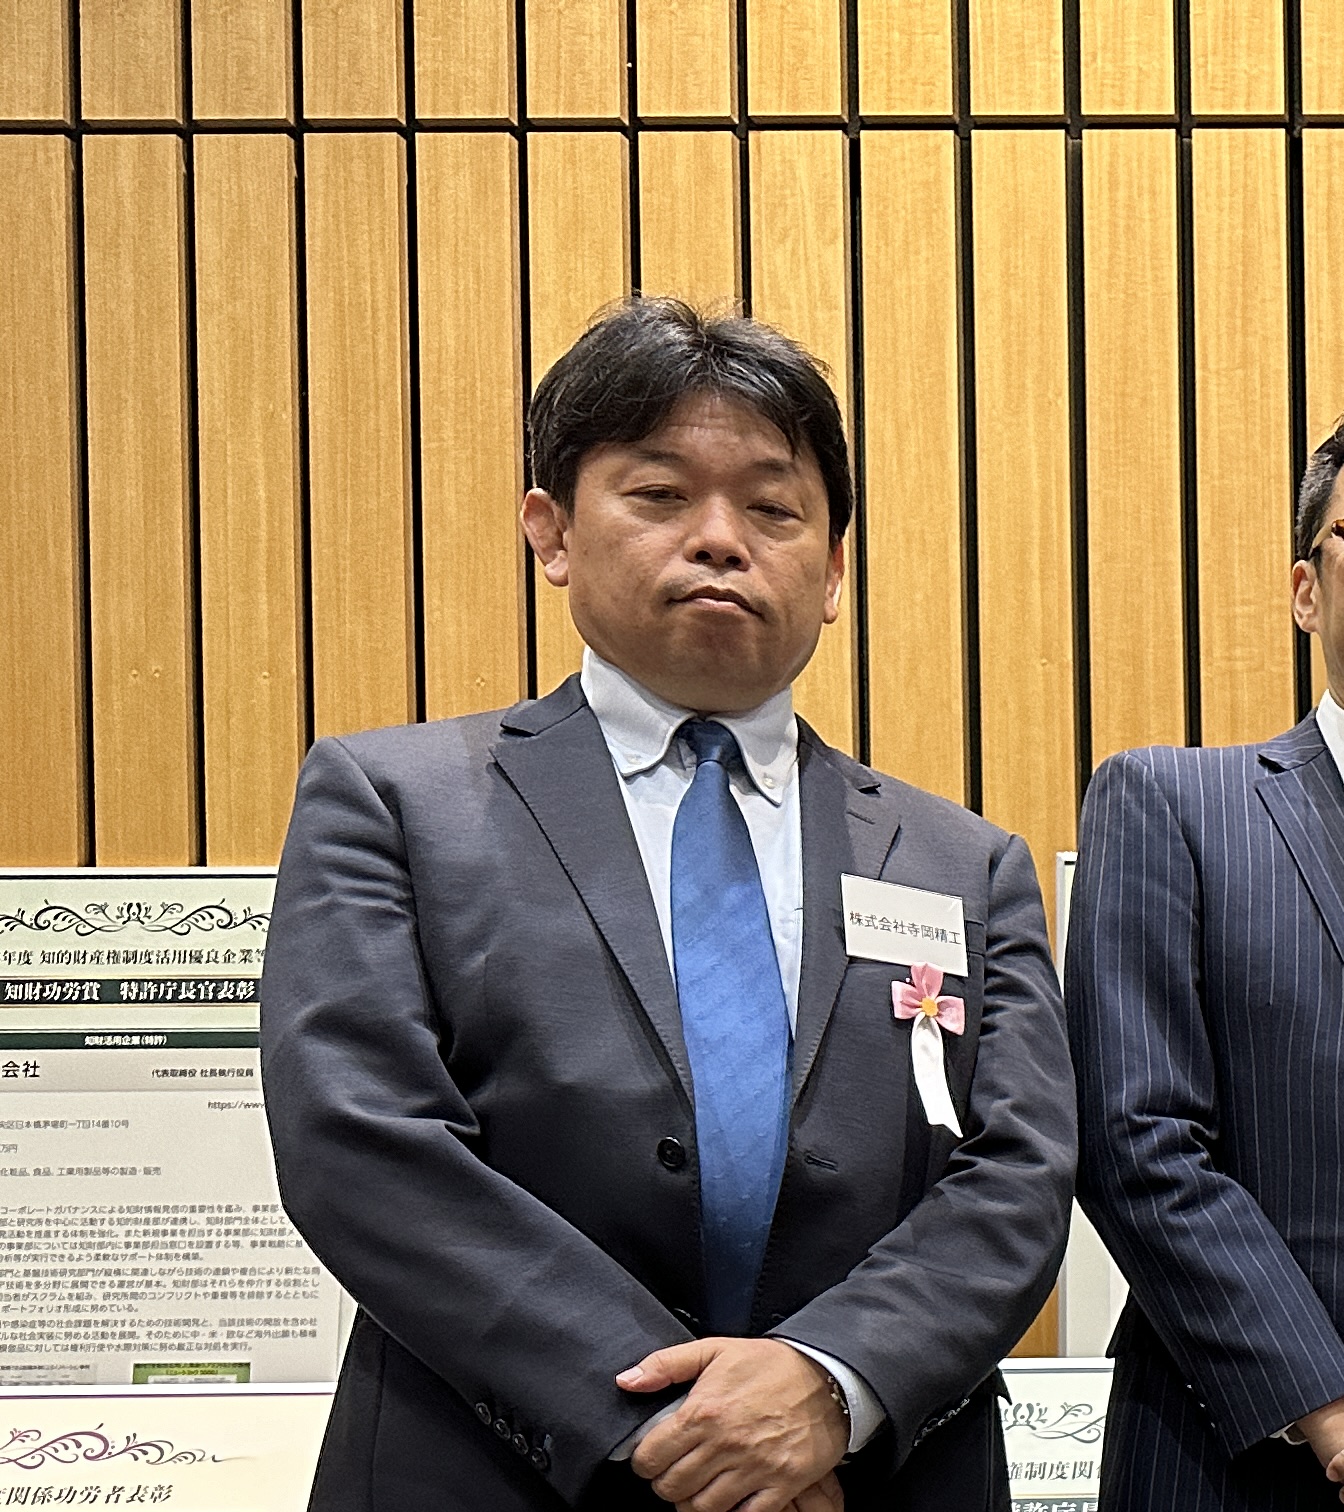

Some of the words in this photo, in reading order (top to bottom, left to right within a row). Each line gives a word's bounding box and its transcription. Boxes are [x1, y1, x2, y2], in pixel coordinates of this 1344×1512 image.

[850, 911, 961, 945] 株式会社寺岡精工
[4, 982, 101, 1001] 知財功労賞
[120, 981, 255, 1000] 特許庁長官表彰
[2, 1061, 40, 1078] 会社
[0, 1484, 173, 1505] 関係功労者表彰
